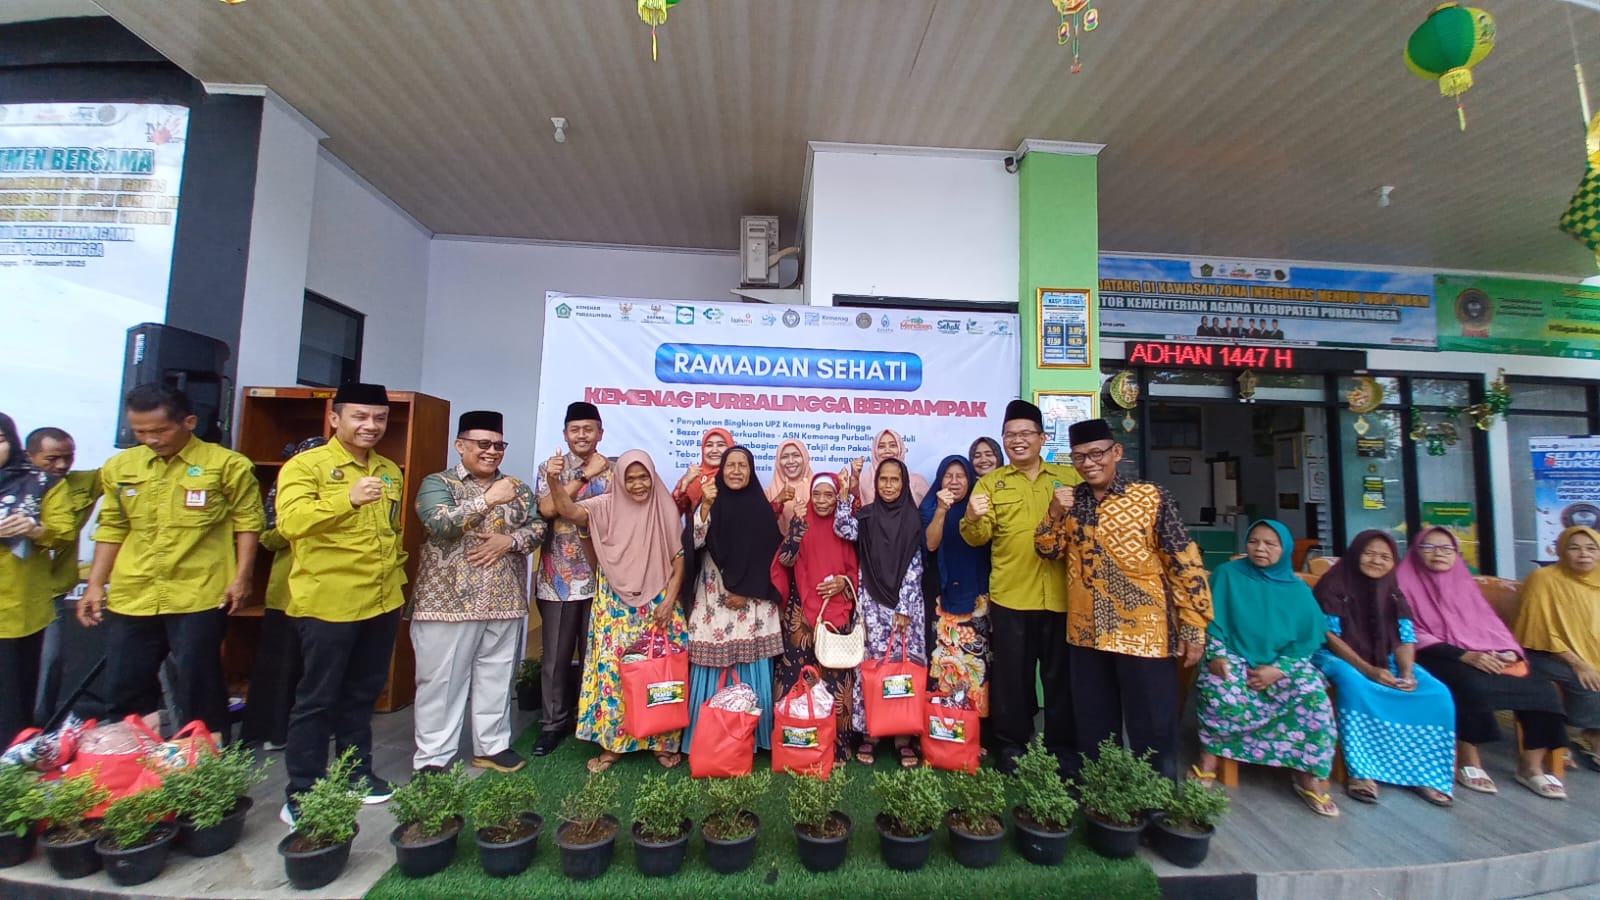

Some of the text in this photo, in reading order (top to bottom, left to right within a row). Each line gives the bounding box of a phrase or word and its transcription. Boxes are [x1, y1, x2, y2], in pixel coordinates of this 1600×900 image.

[51, 149, 153, 172] BERSAMA
[1143, 281, 1155, 293] DI
[1158, 282, 1216, 296] KAWASAN
[1219, 285, 1248, 298] ZONA
[1250, 287, 1314, 301] INTEGRITAS
[1101, 296, 1399, 321] TOR KEMENTERIAN AGAMA KABUPATEN PURBALINGGA
[673, 352, 907, 382] RAMADAN SEHATI
[1130, 343, 1294, 369] ADHAN 1447 H
[584, 386, 988, 418] KEMENAG PURBALINGGA BERDAMPAK
[676, 417, 872, 432] Penyaluran Bingkisan UPZ Kemenag Purbalingga
[676, 428, 700, 436] Bazar
[802, 432, 839, 442] Kemenag
[842, 433, 874, 441] Purbalin
[675, 450, 700, 458] Tebar
